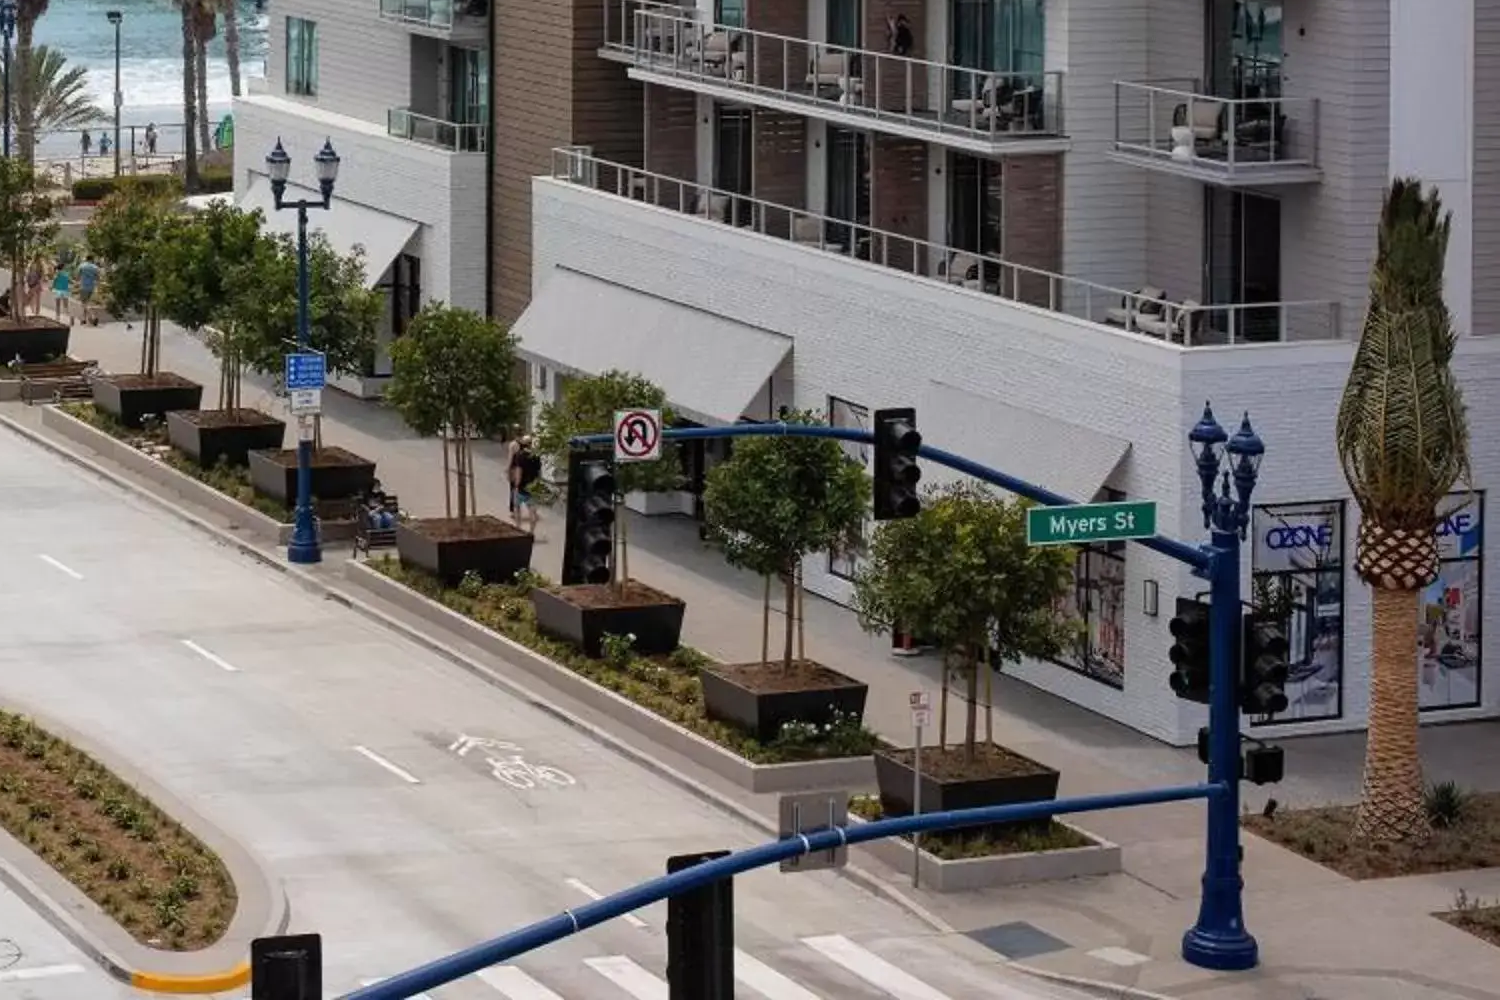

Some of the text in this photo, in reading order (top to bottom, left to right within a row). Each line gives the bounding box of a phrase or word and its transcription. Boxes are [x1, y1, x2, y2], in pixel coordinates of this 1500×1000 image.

[1049, 511, 1135, 538] Myers St
[1266, 525, 1333, 550] OZONE
